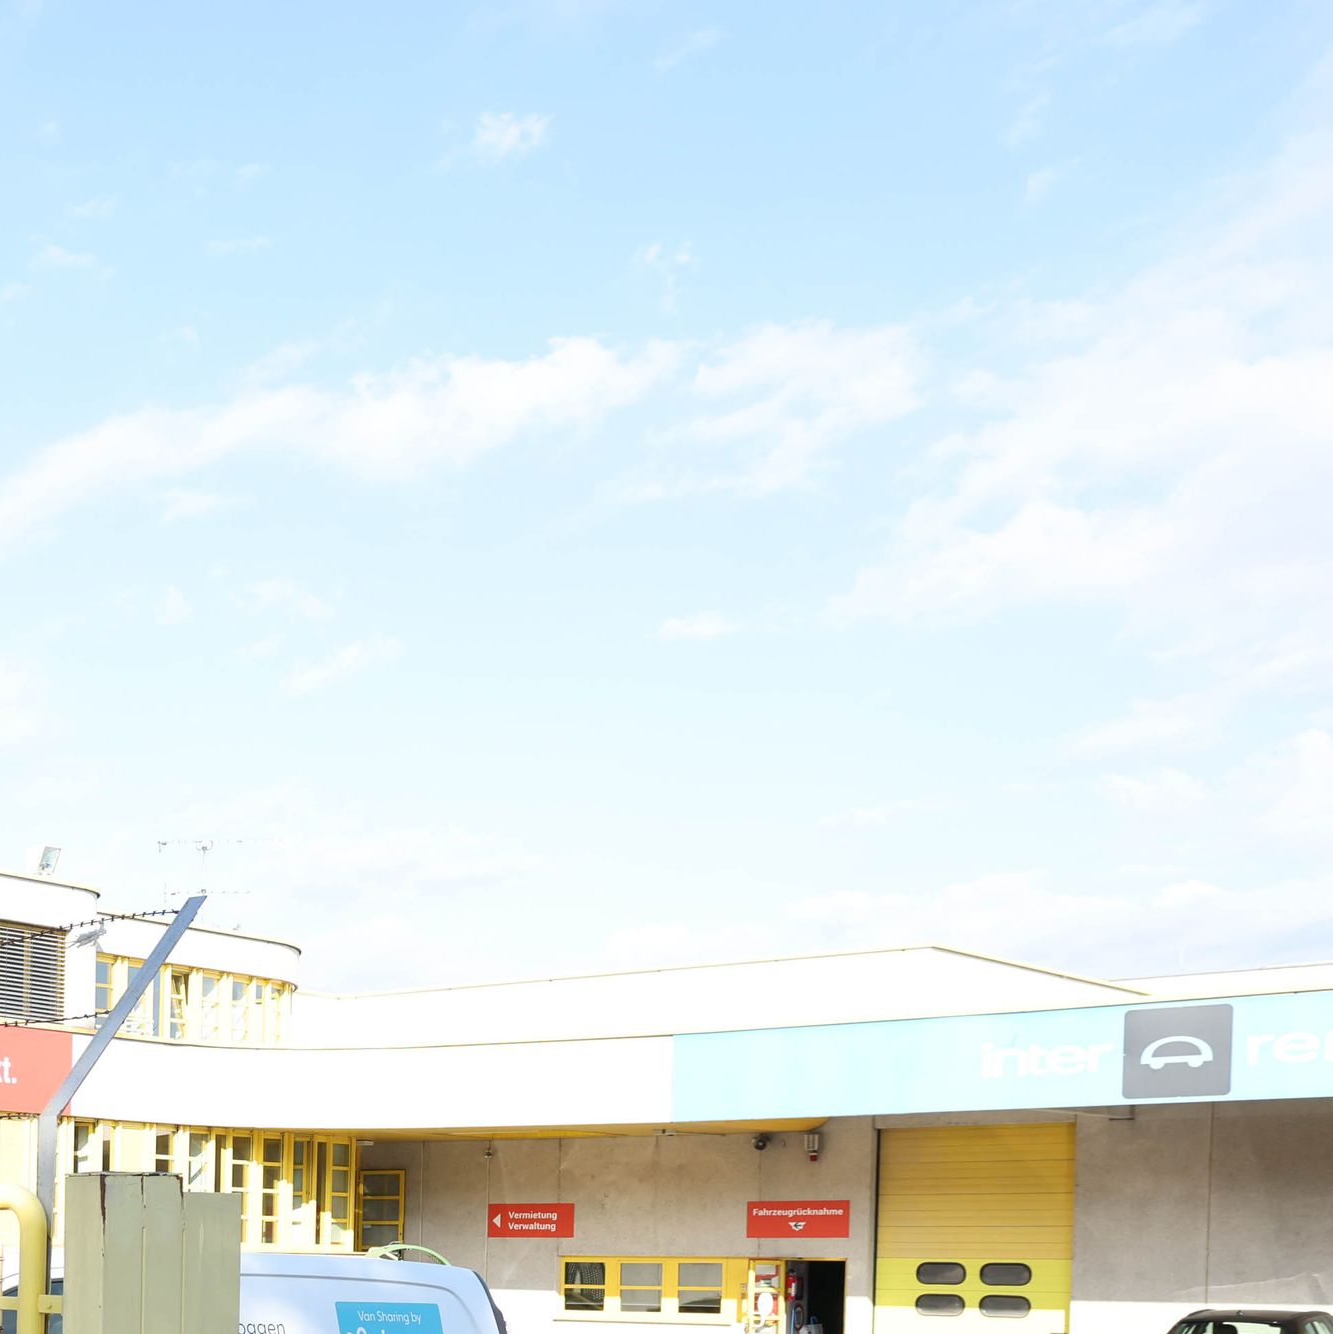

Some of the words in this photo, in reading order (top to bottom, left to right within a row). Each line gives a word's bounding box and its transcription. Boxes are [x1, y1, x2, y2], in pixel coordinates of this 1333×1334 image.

[982, 1042, 1115, 1079] inter
[1245, 1030, 1333, 1067] re
[508, 1210, 557, 1221] Vermietung
[753, 1207, 844, 1217] Fahrzeugrücknahme
[508, 1222, 556, 1232] Verwaltung
[357, 1310, 376, 1322] Van
[376, 1310, 410, 1326] Sharing
[411, 1310, 422, 1326] by
